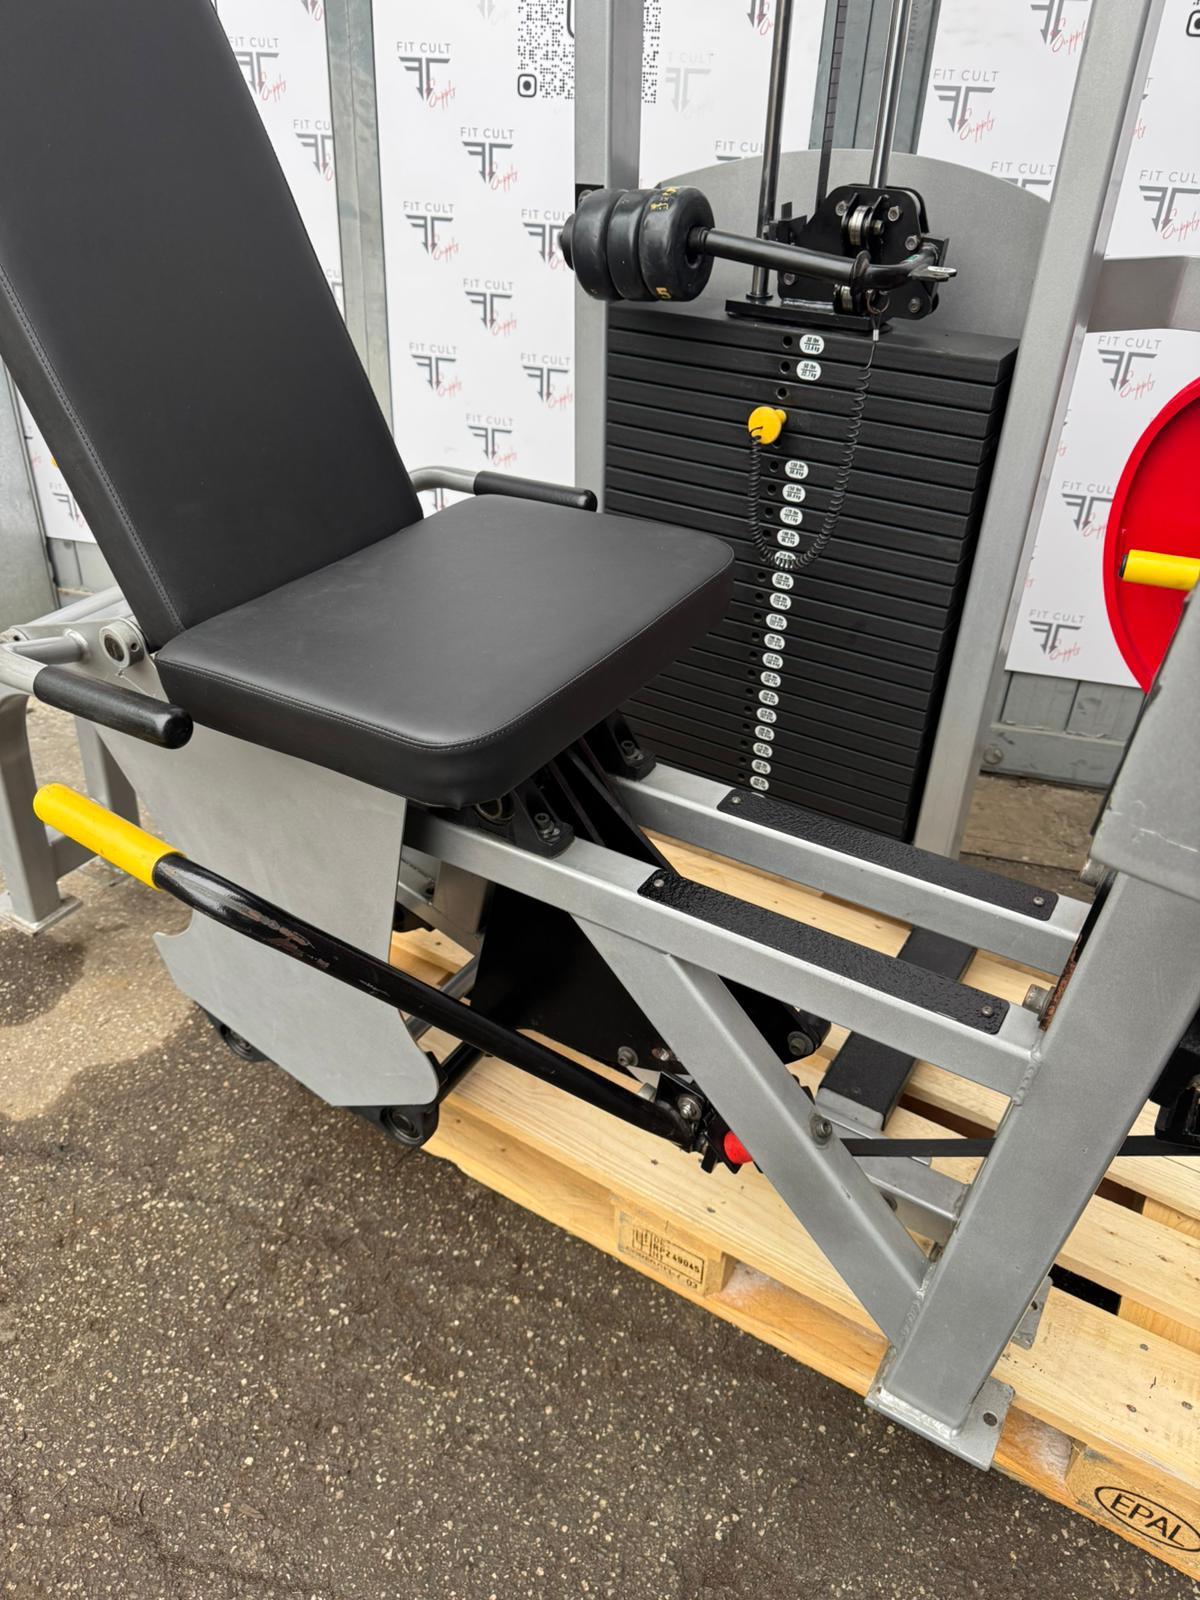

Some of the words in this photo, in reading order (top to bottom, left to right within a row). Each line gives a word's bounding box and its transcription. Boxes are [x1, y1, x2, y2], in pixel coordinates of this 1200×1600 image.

[228, 36, 245, 47] FIT
[250, 37, 279, 48] CULT
[396, 41, 415, 53] FIT
[419, 42, 452, 54] CULT
[932, 68, 956, 81] FIT
[961, 69, 1000, 82] CULT
[293, 119, 311, 129] FIT
[314, 120, 331, 131] CU
[460, 127, 478, 138] FIT
[482, 128, 514, 140] CULT
[715, 140, 735, 151] FIT
[990, 161, 1014, 173] FIT
[1018, 163, 1056, 175] CULT
[1139, 169, 1163, 181] FIT
[1168, 171, 1199, 184] CUL
[403, 201, 421, 212] FIT
[425, 202, 454, 214] CULT
[521, 209, 539, 220] FIT
[543, 210, 572, 221] CUL
[463, 278, 480, 289] FIT
[485, 280, 514, 291] CULT
[409, 342, 426, 352] FIT
[430, 343, 457, 355] CULT
[1098, 335, 1122, 347] FIT
[1125, 337, 1162, 350] CULT
[521, 352, 539, 363] FIT
[542, 354, 571, 366] CULT
[465, 413, 482, 423] FIT
[486, 415, 513, 427] CULT
[1061, 480, 1082, 491] FIT
[1086, 483, 1113, 495] CUL
[1028, 608, 1049, 620] FIT
[1052, 611, 1085, 623] CULT
[1110, 1493, 1185, 1548] EPAL
